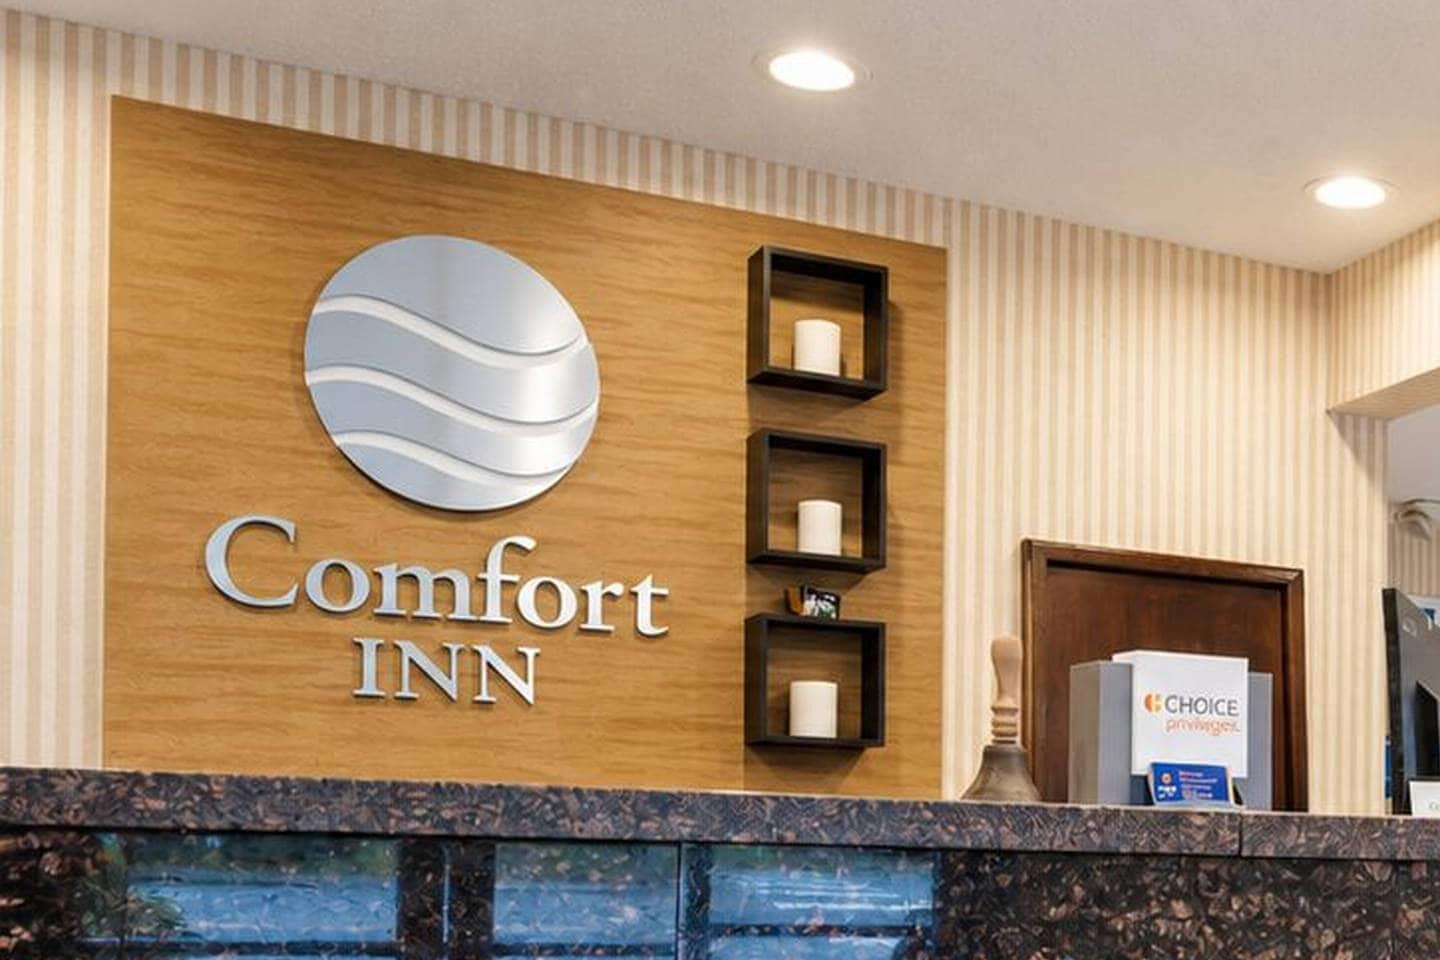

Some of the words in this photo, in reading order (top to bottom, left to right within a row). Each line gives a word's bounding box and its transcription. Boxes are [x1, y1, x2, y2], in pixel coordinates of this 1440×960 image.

[203, 514, 671, 637] Comfort
[352, 636, 542, 706] INN
[1164, 694, 1240, 717] CHOICE
